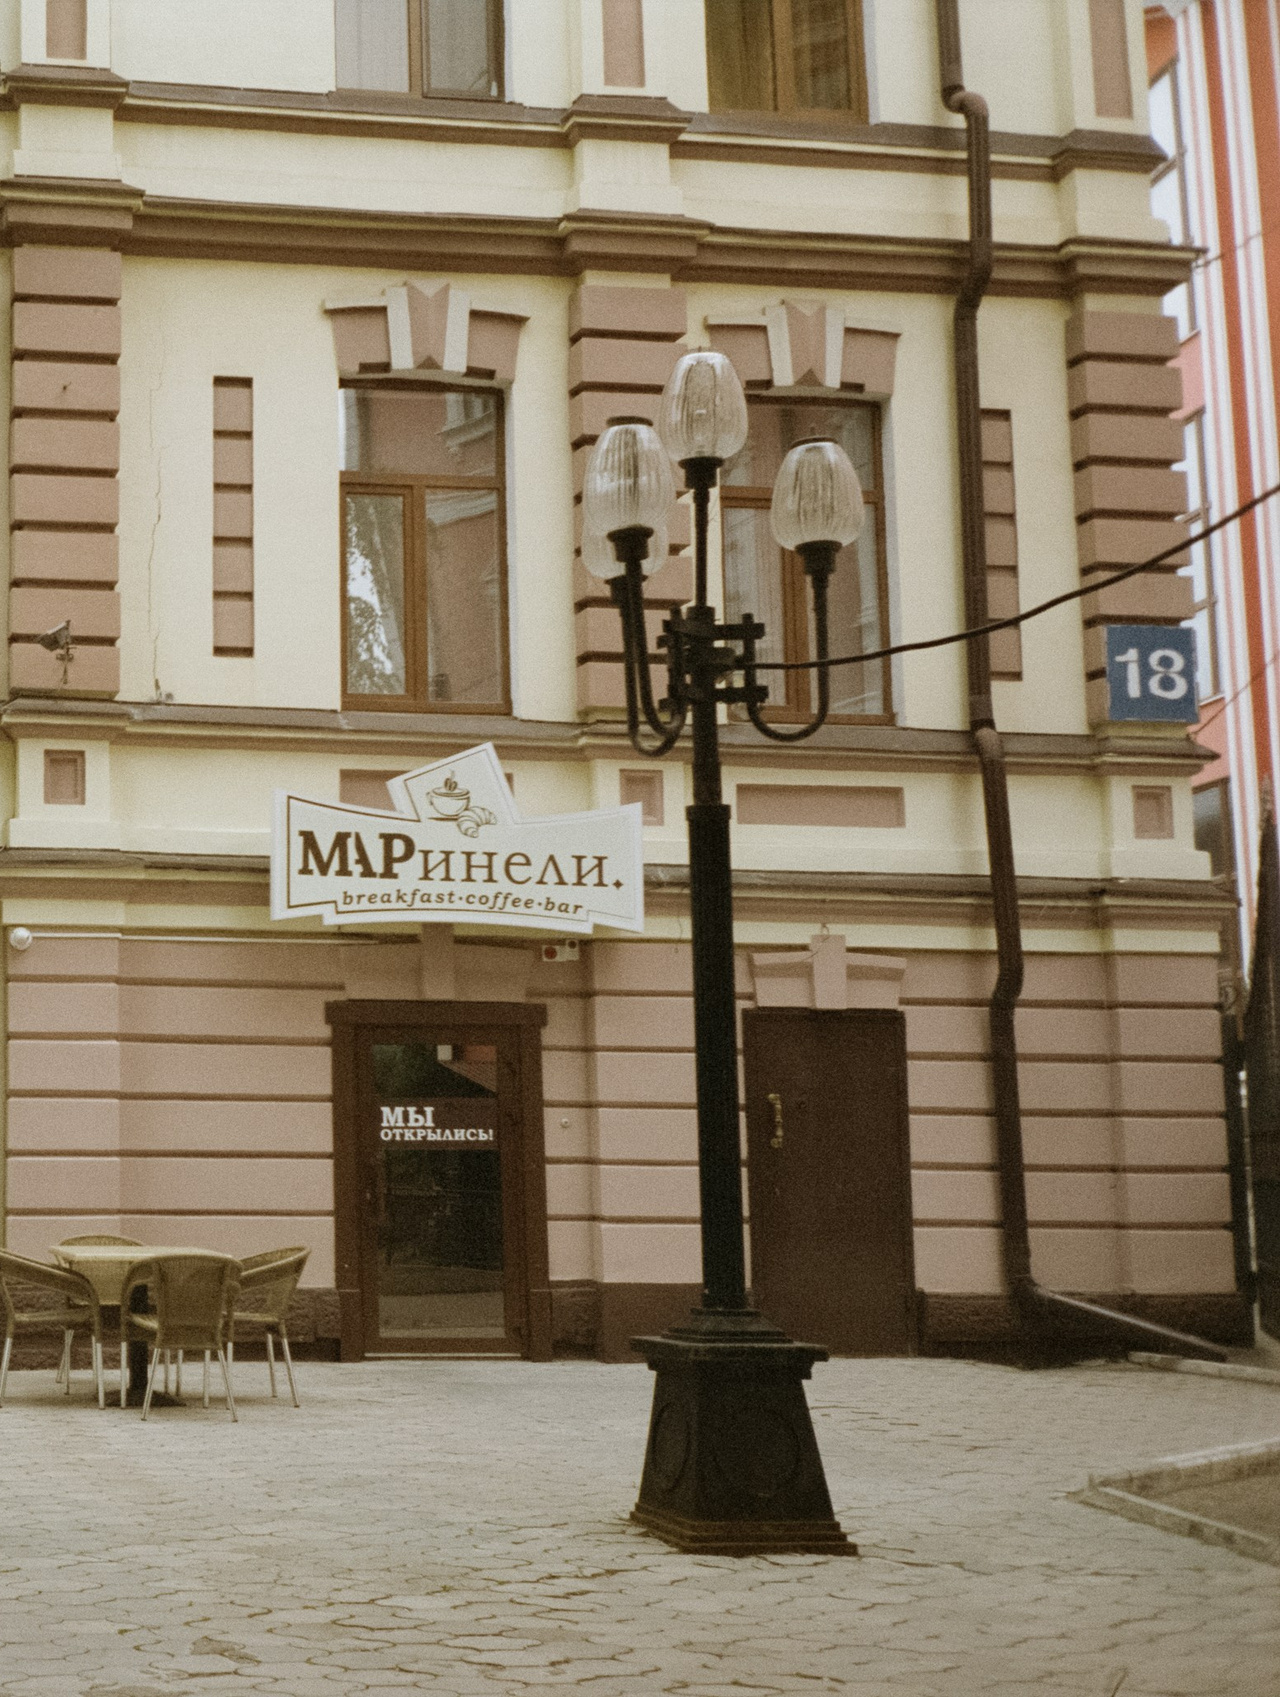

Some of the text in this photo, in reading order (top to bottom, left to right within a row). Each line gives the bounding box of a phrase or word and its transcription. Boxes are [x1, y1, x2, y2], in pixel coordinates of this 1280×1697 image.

[1114, 647, 1189, 701] 18
[380, 1106, 435, 1127] МЫ
[380, 1128, 494, 1141] ОТКРЫЛИСЬ!
